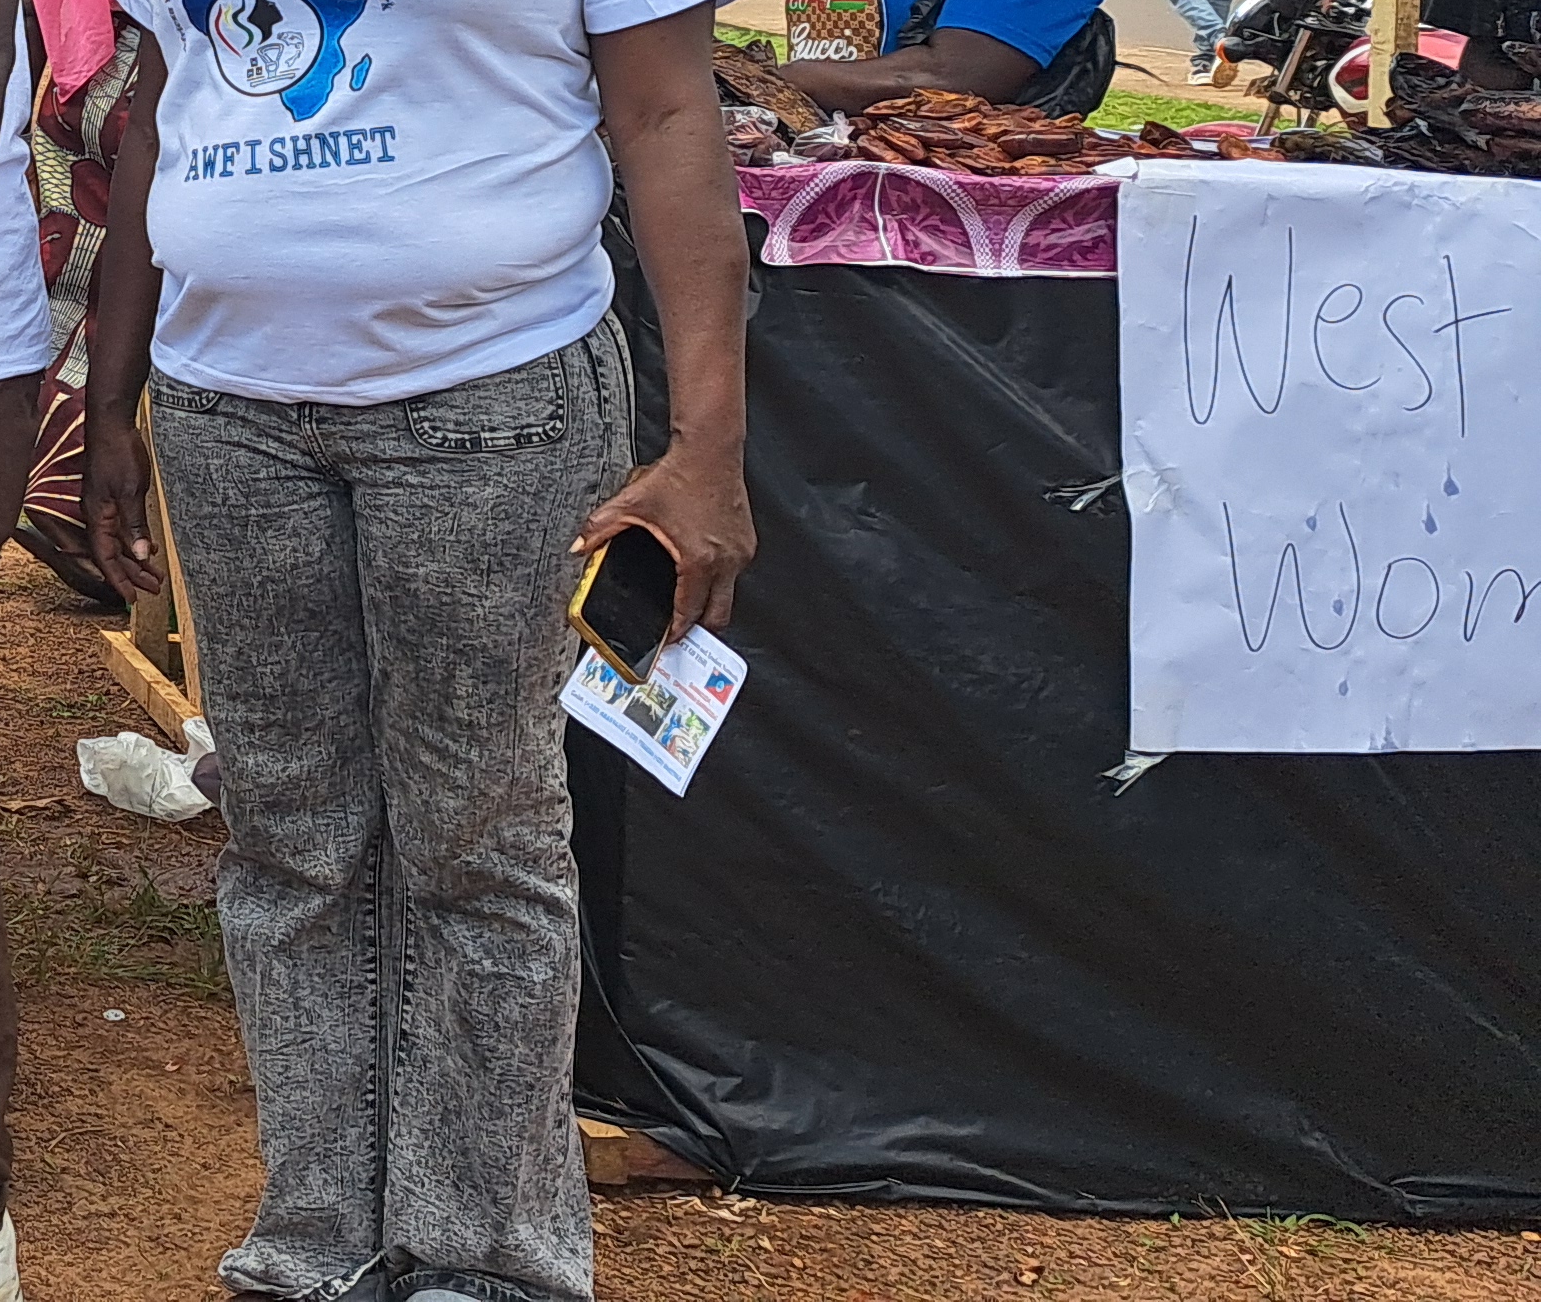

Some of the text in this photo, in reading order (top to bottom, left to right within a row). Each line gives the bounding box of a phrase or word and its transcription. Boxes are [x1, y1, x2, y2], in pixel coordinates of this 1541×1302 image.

[790, 22, 859, 62] Gucci
[183, 125, 396, 183] AWFISHNET
[1183, 214, 1513, 438] West
